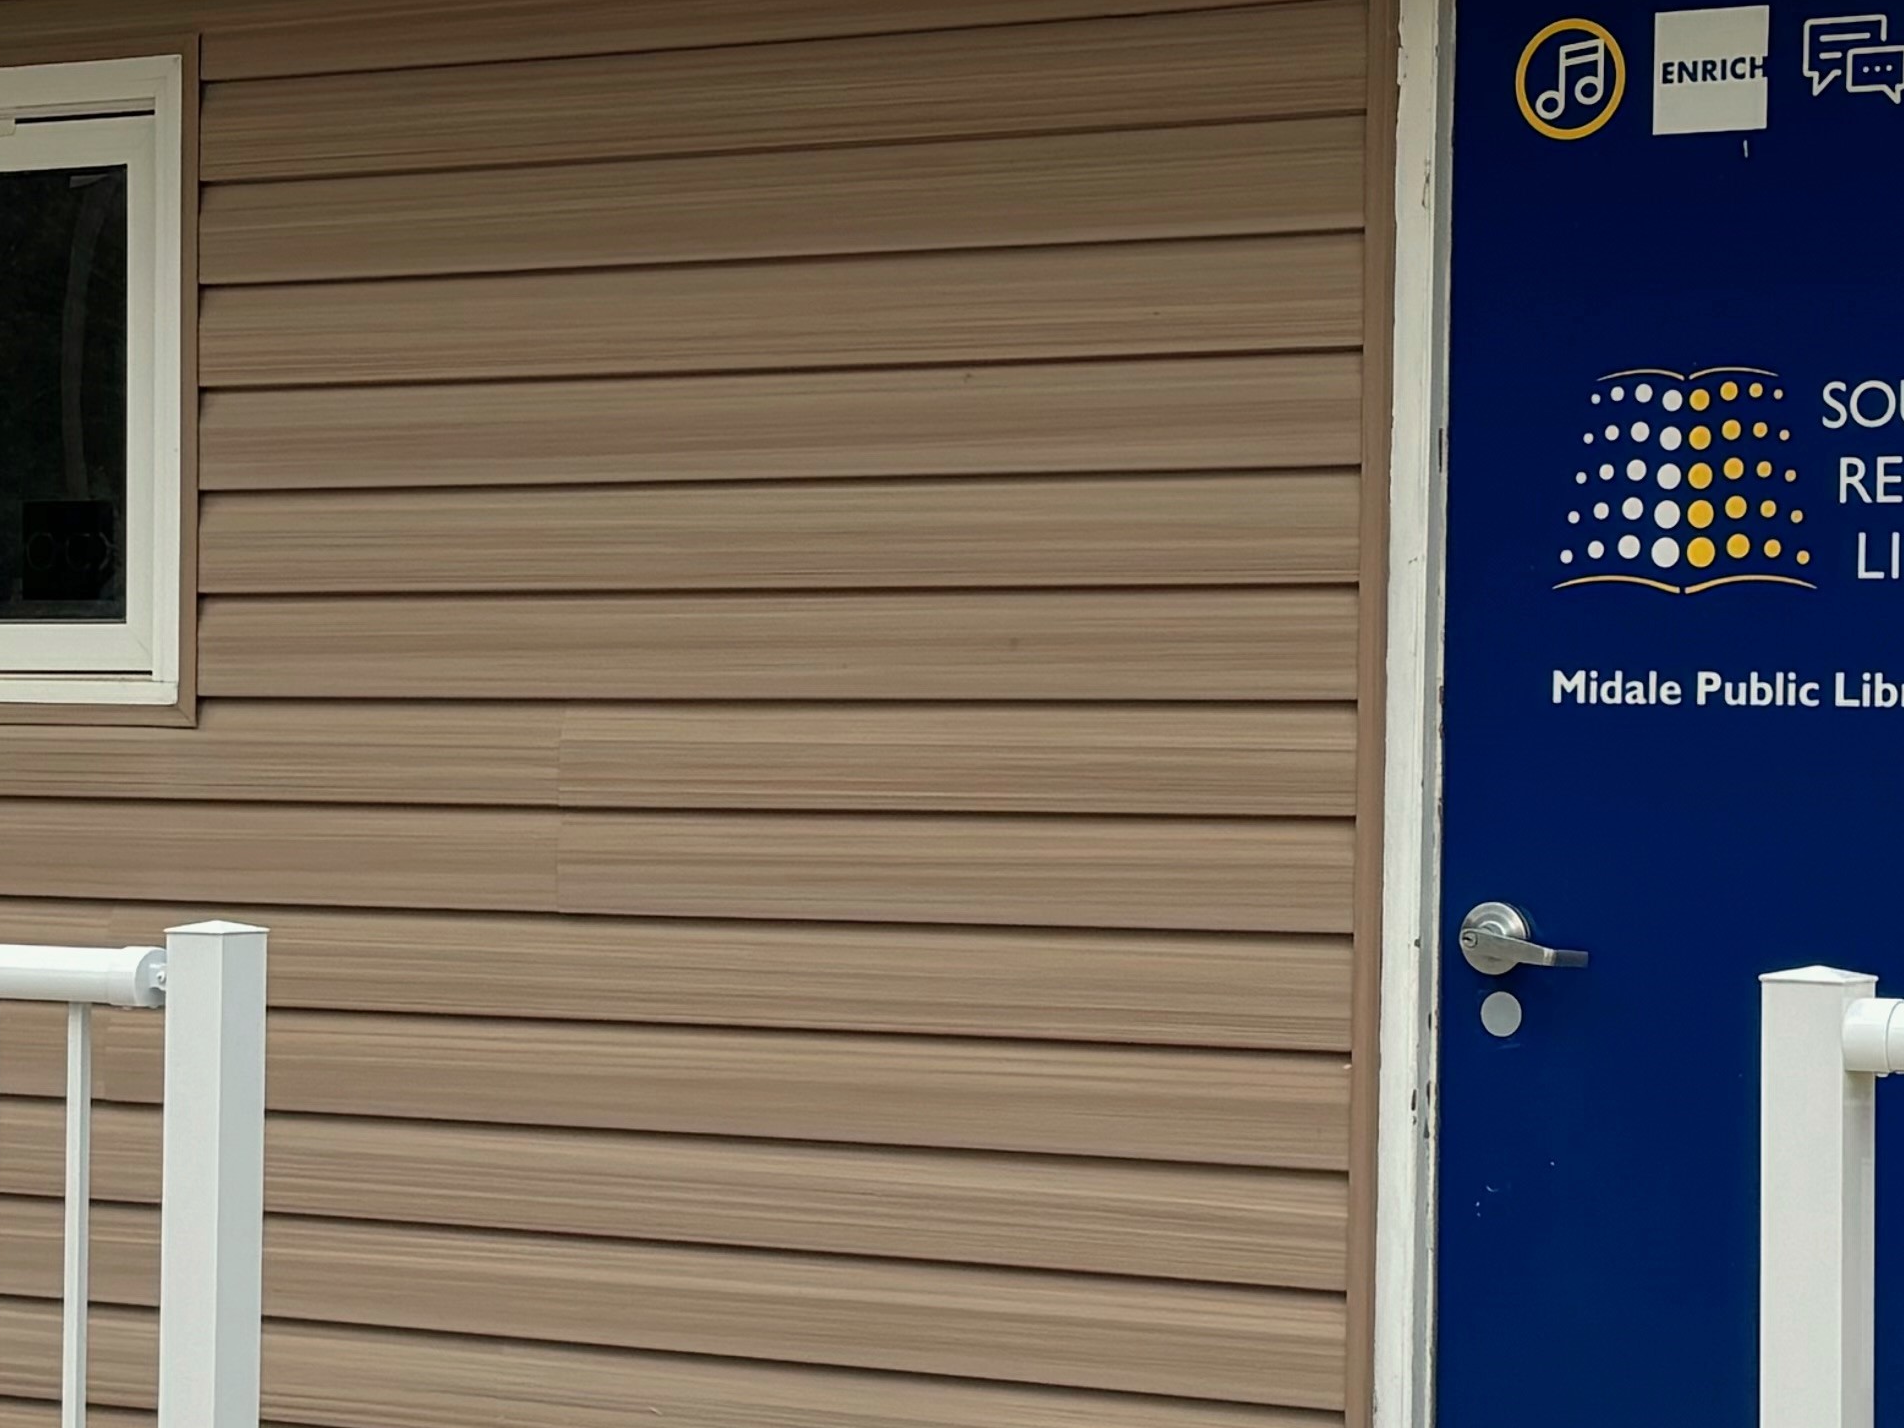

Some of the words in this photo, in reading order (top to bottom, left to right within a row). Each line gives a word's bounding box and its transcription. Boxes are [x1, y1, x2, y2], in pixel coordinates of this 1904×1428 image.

[1661, 56, 1769, 84] ENRICH
[1552, 670, 1683, 706] Midale
[1697, 671, 1820, 707] Public
